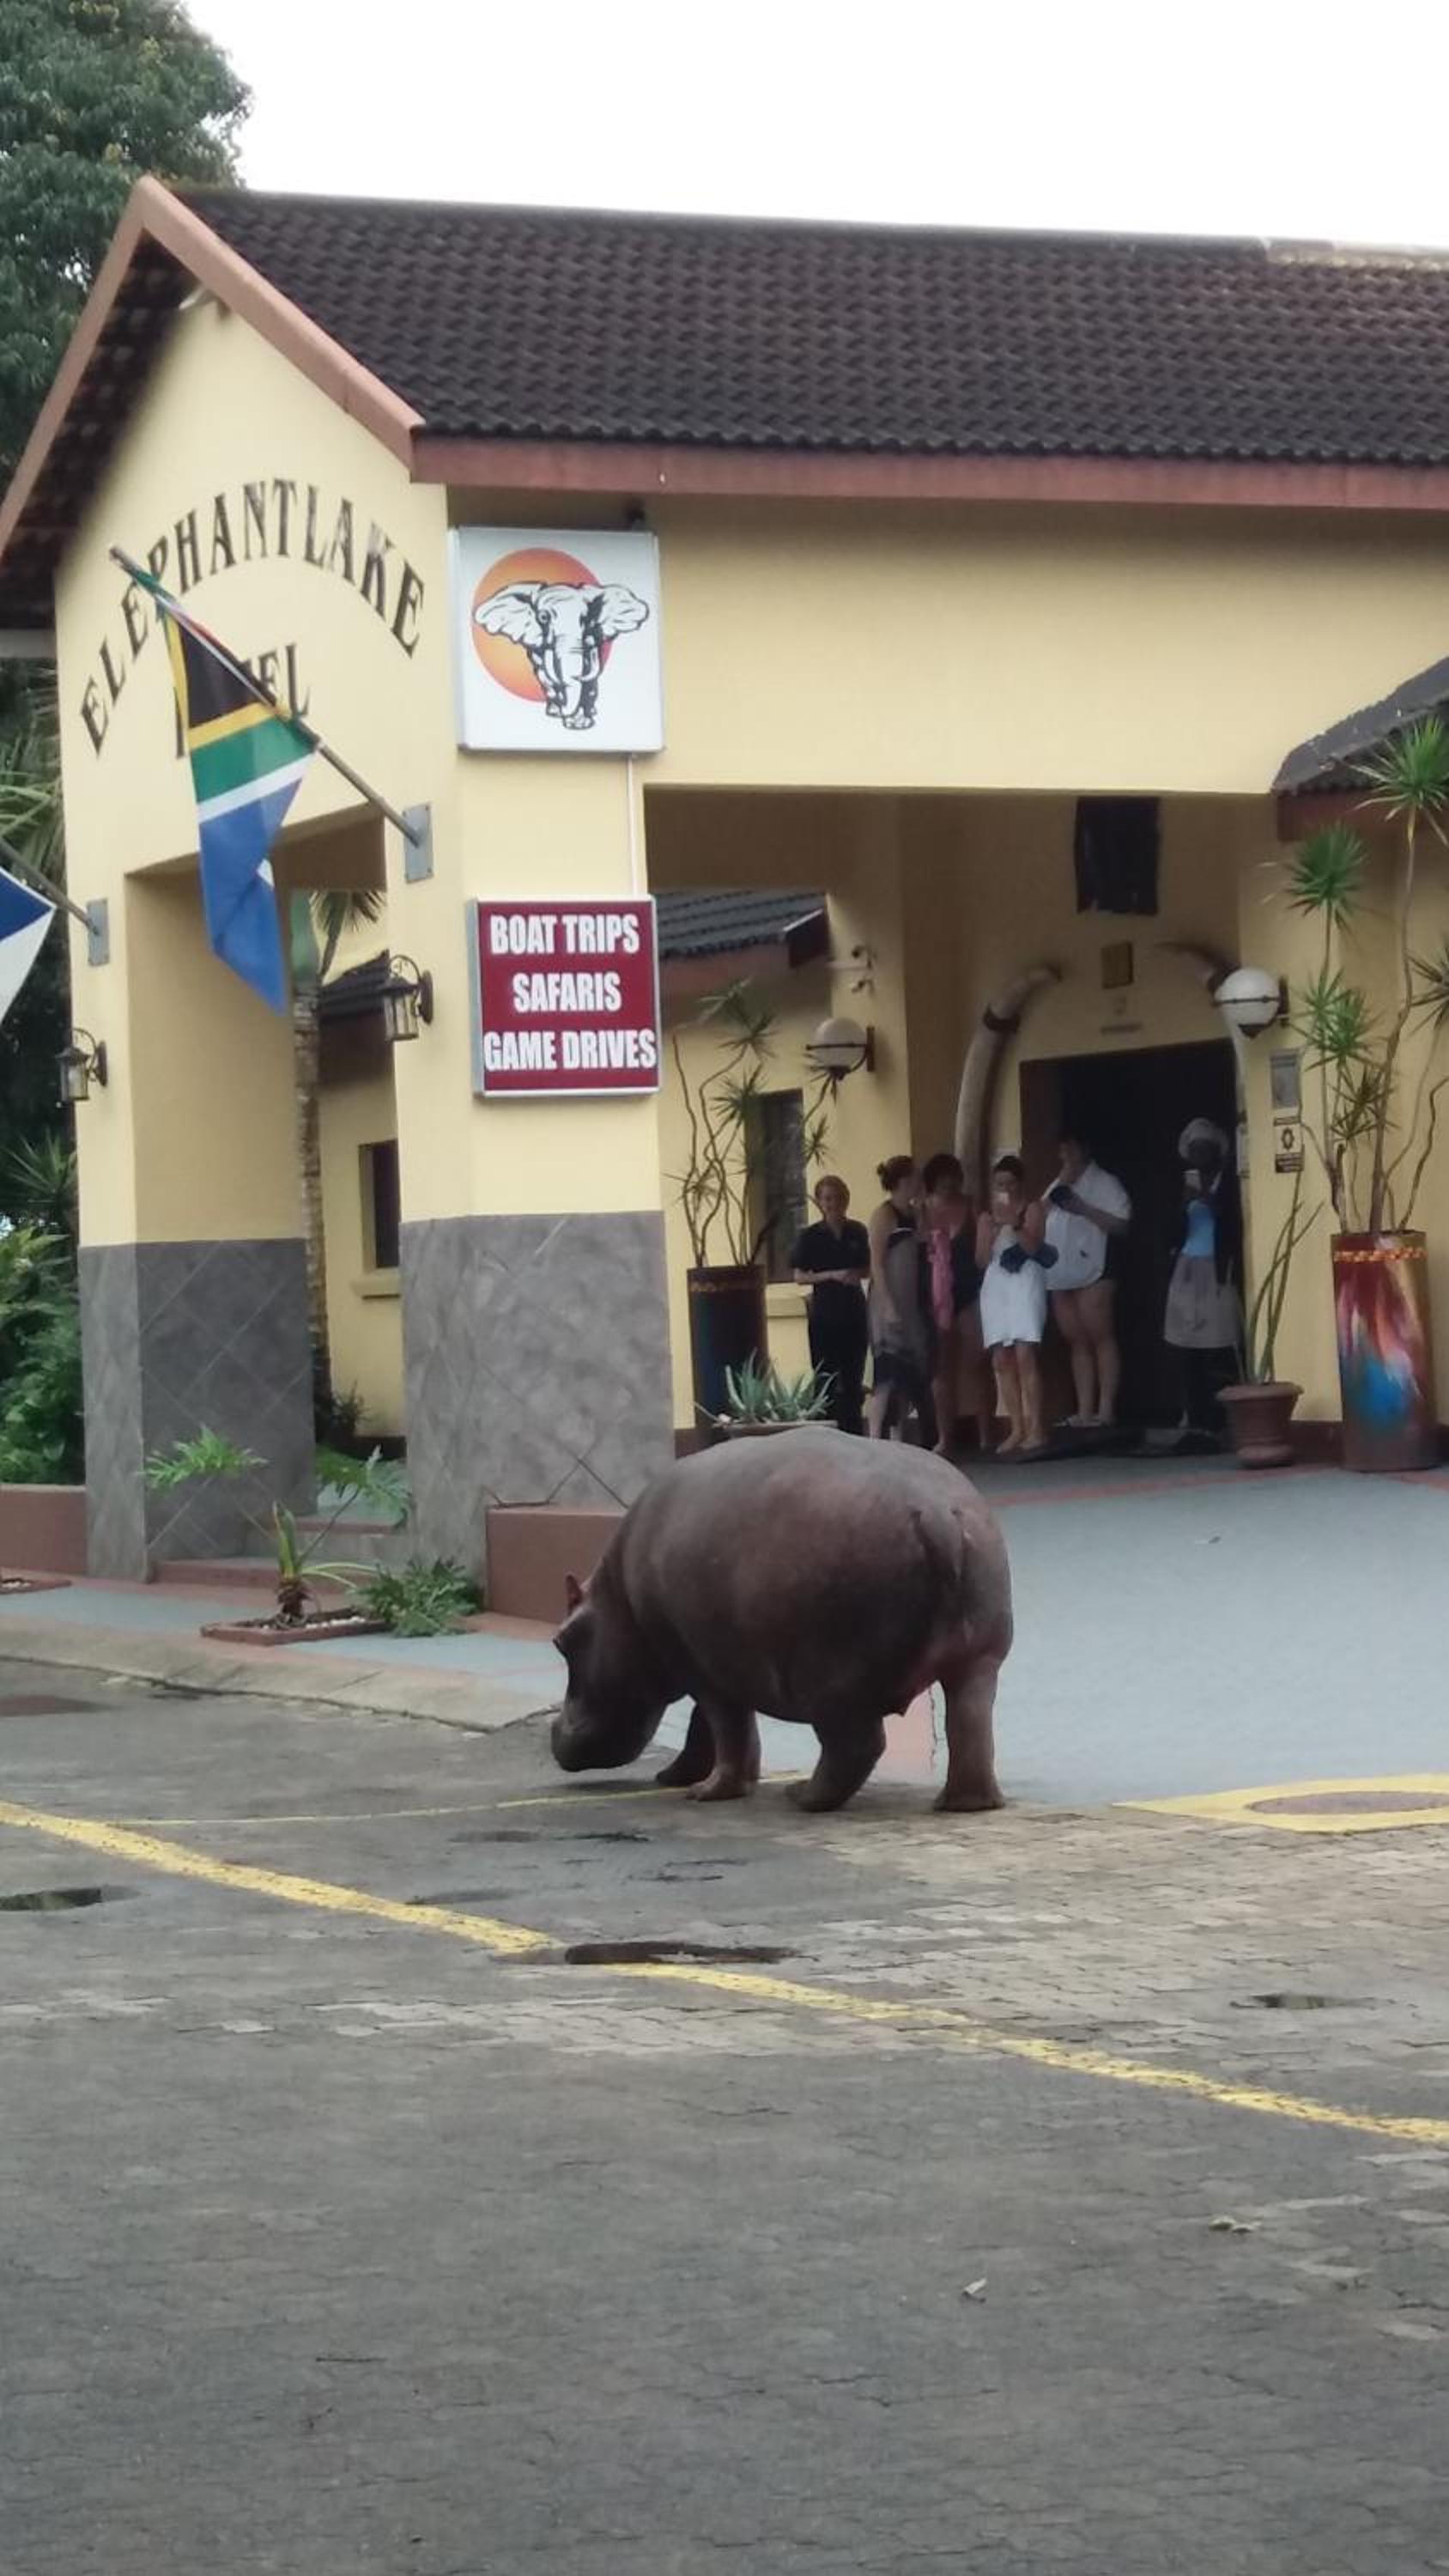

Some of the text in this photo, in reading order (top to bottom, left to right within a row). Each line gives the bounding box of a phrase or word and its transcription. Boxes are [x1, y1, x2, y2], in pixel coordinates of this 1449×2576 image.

[490, 914, 640, 954] BOAT TRIPS
[512, 971, 622, 1013] SAFARIS
[483, 1029, 657, 1072] GAME DRIVES
